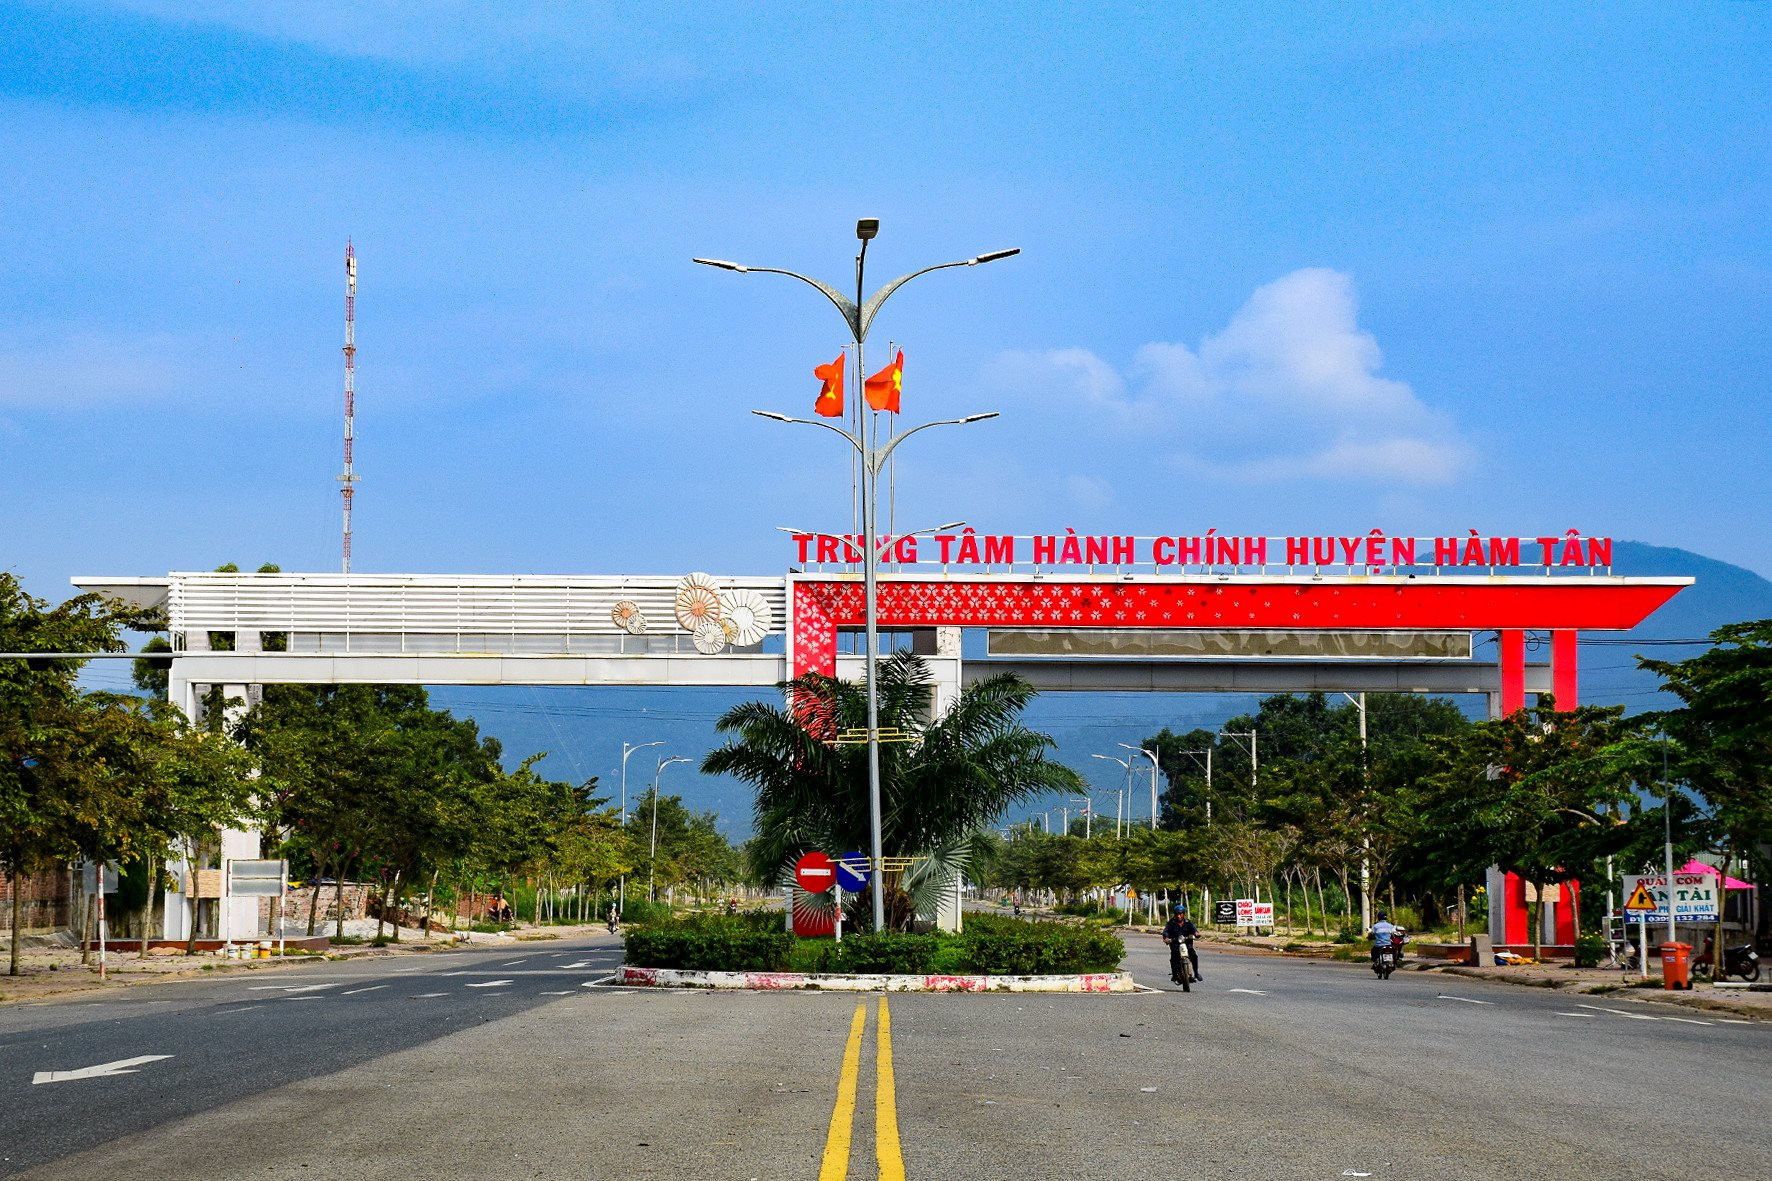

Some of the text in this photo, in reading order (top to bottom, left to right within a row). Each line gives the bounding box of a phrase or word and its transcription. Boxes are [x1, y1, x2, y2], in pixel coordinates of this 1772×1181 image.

[935, 528, 1014, 563] TÂM
[1034, 527, 1134, 564] HÀNH
[1153, 528, 1266, 565] CHÍNH
[1286, 528, 1414, 573] HUYỆN
[1435, 528, 1519, 566] HÀM
[1537, 528, 1612, 566] TÂN
[1676, 877, 1702, 885] CƠM
[1677, 887, 1711, 901] TÀI
